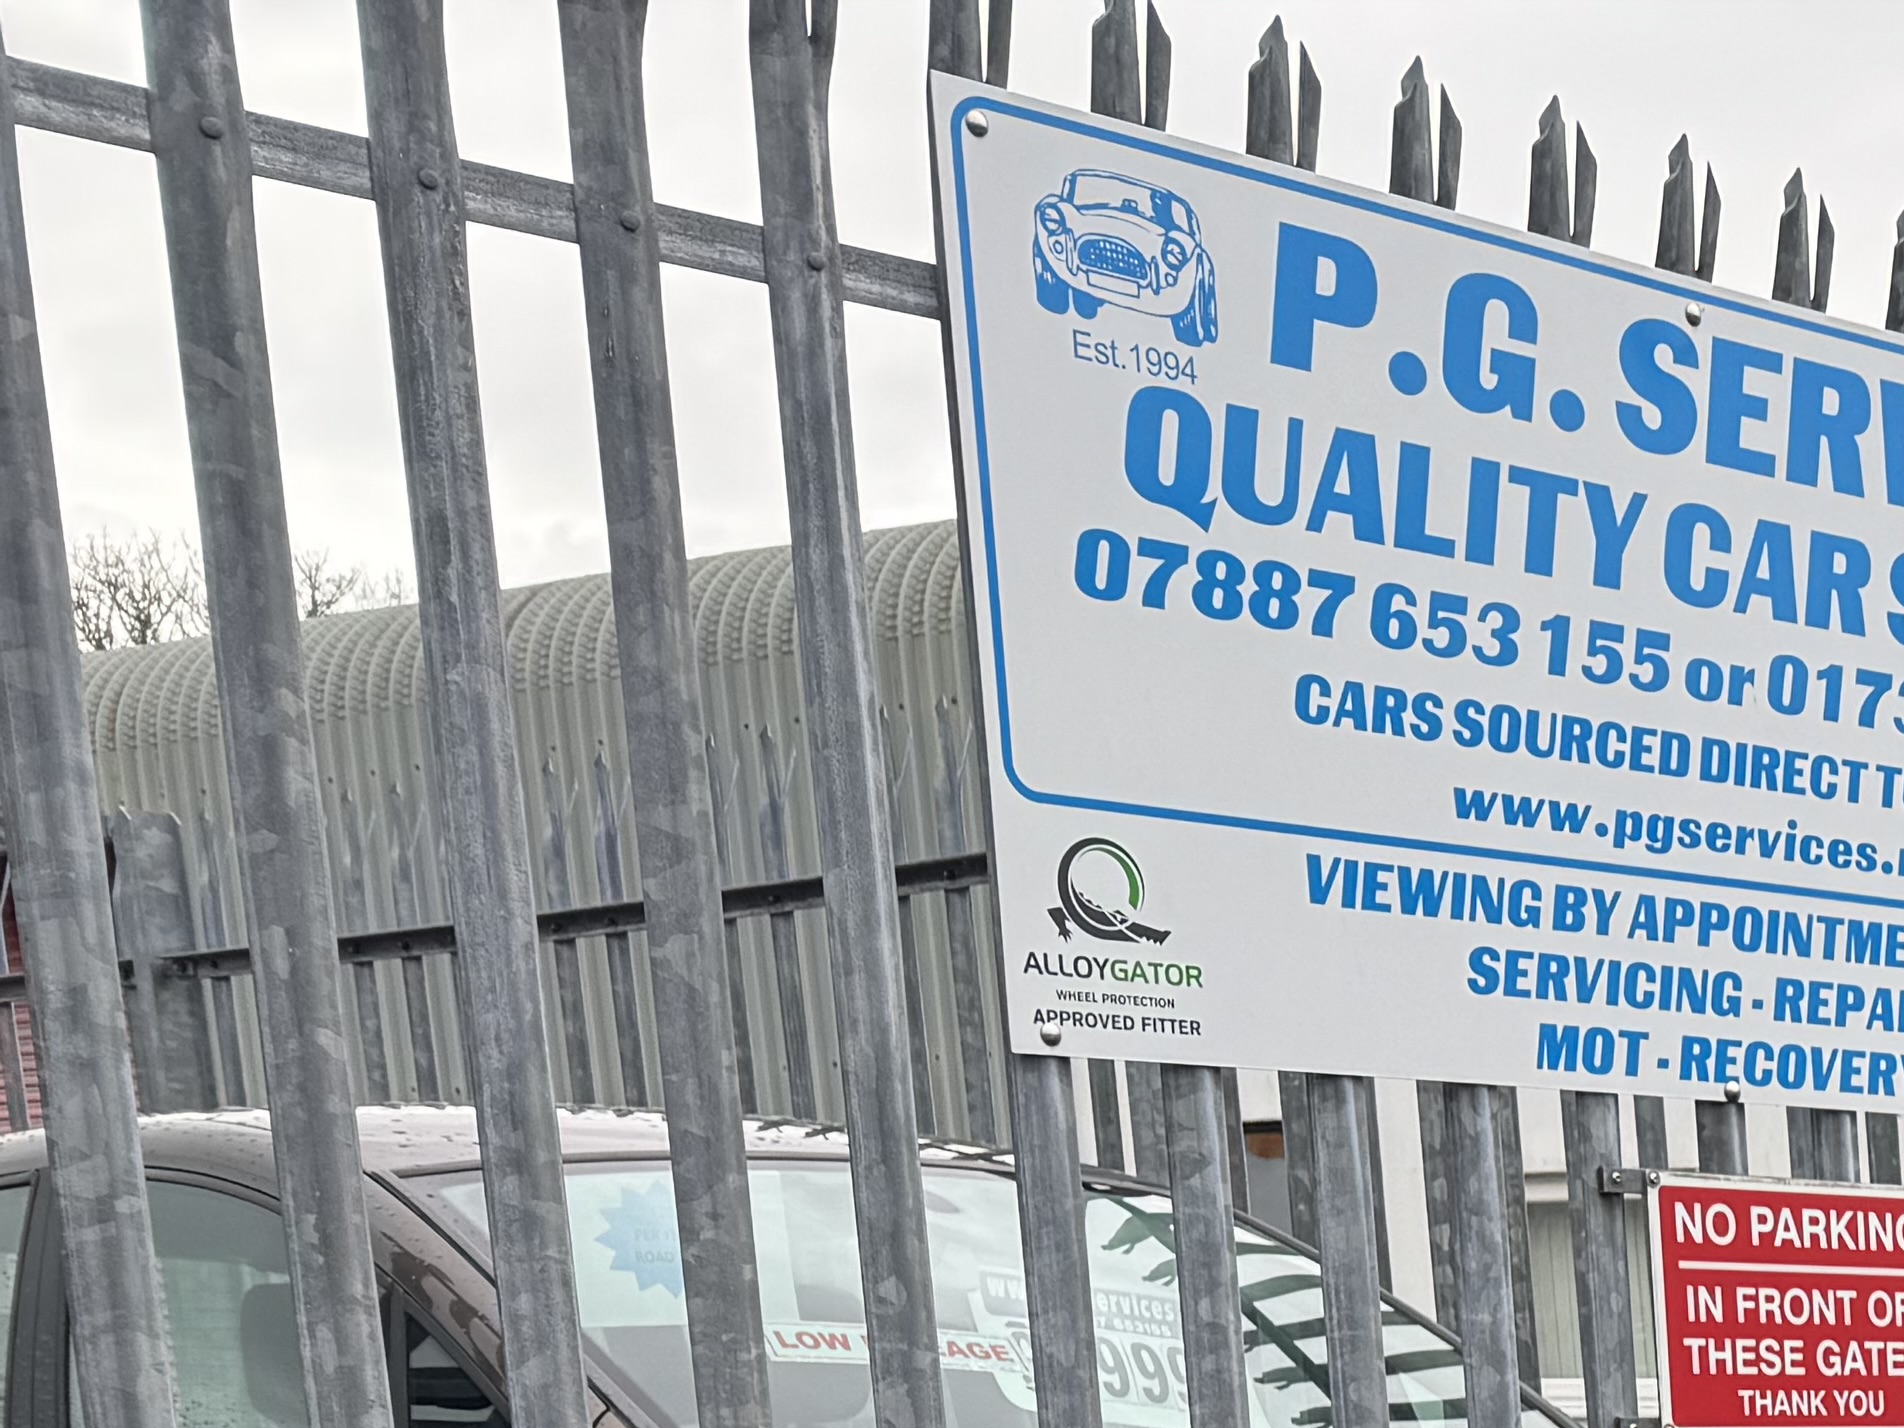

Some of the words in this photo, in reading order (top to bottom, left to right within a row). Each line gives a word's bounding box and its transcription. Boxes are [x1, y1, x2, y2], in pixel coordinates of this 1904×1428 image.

[1125, 386, 1648, 590] QUALITY
[1663, 503, 1872, 638] CAR
[1074, 528, 1356, 638] 07887
[1370, 583, 1520, 667] 653
[1540, 614, 1671, 692] 155
[1685, 657, 1755, 705] or
[1295, 673, 1445, 741] CARS
[1452, 698, 1690, 779] SOURCED
[1700, 736, 1869, 802] DIRECT
[1305, 853, 1542, 929] VIEWING
[1552, 884, 1621, 936] BY
[1023, 952, 1204, 989] ALLOYGATOR
[1467, 946, 1743, 1018] SERVICING
[1056, 989, 1098, 1004] WHEEL
[1101, 993, 1176, 1009] PROTECTION
[1033, 1008, 1135, 1032] APPROVED
[1141, 1016, 1202, 1036] FITTER
[1537, 1023, 1650, 1077] MOT
[1674, 1202, 1737, 1246] NO
[1686, 1285, 1724, 1323] IN
[1735, 1286, 1857, 1325] FRONT
[773, 1330, 851, 1352] LOW
[1682, 1338, 1806, 1376] THESE
[1737, 1389, 1828, 1417] THANK
[1833, 1389, 1885, 1417] YOU
